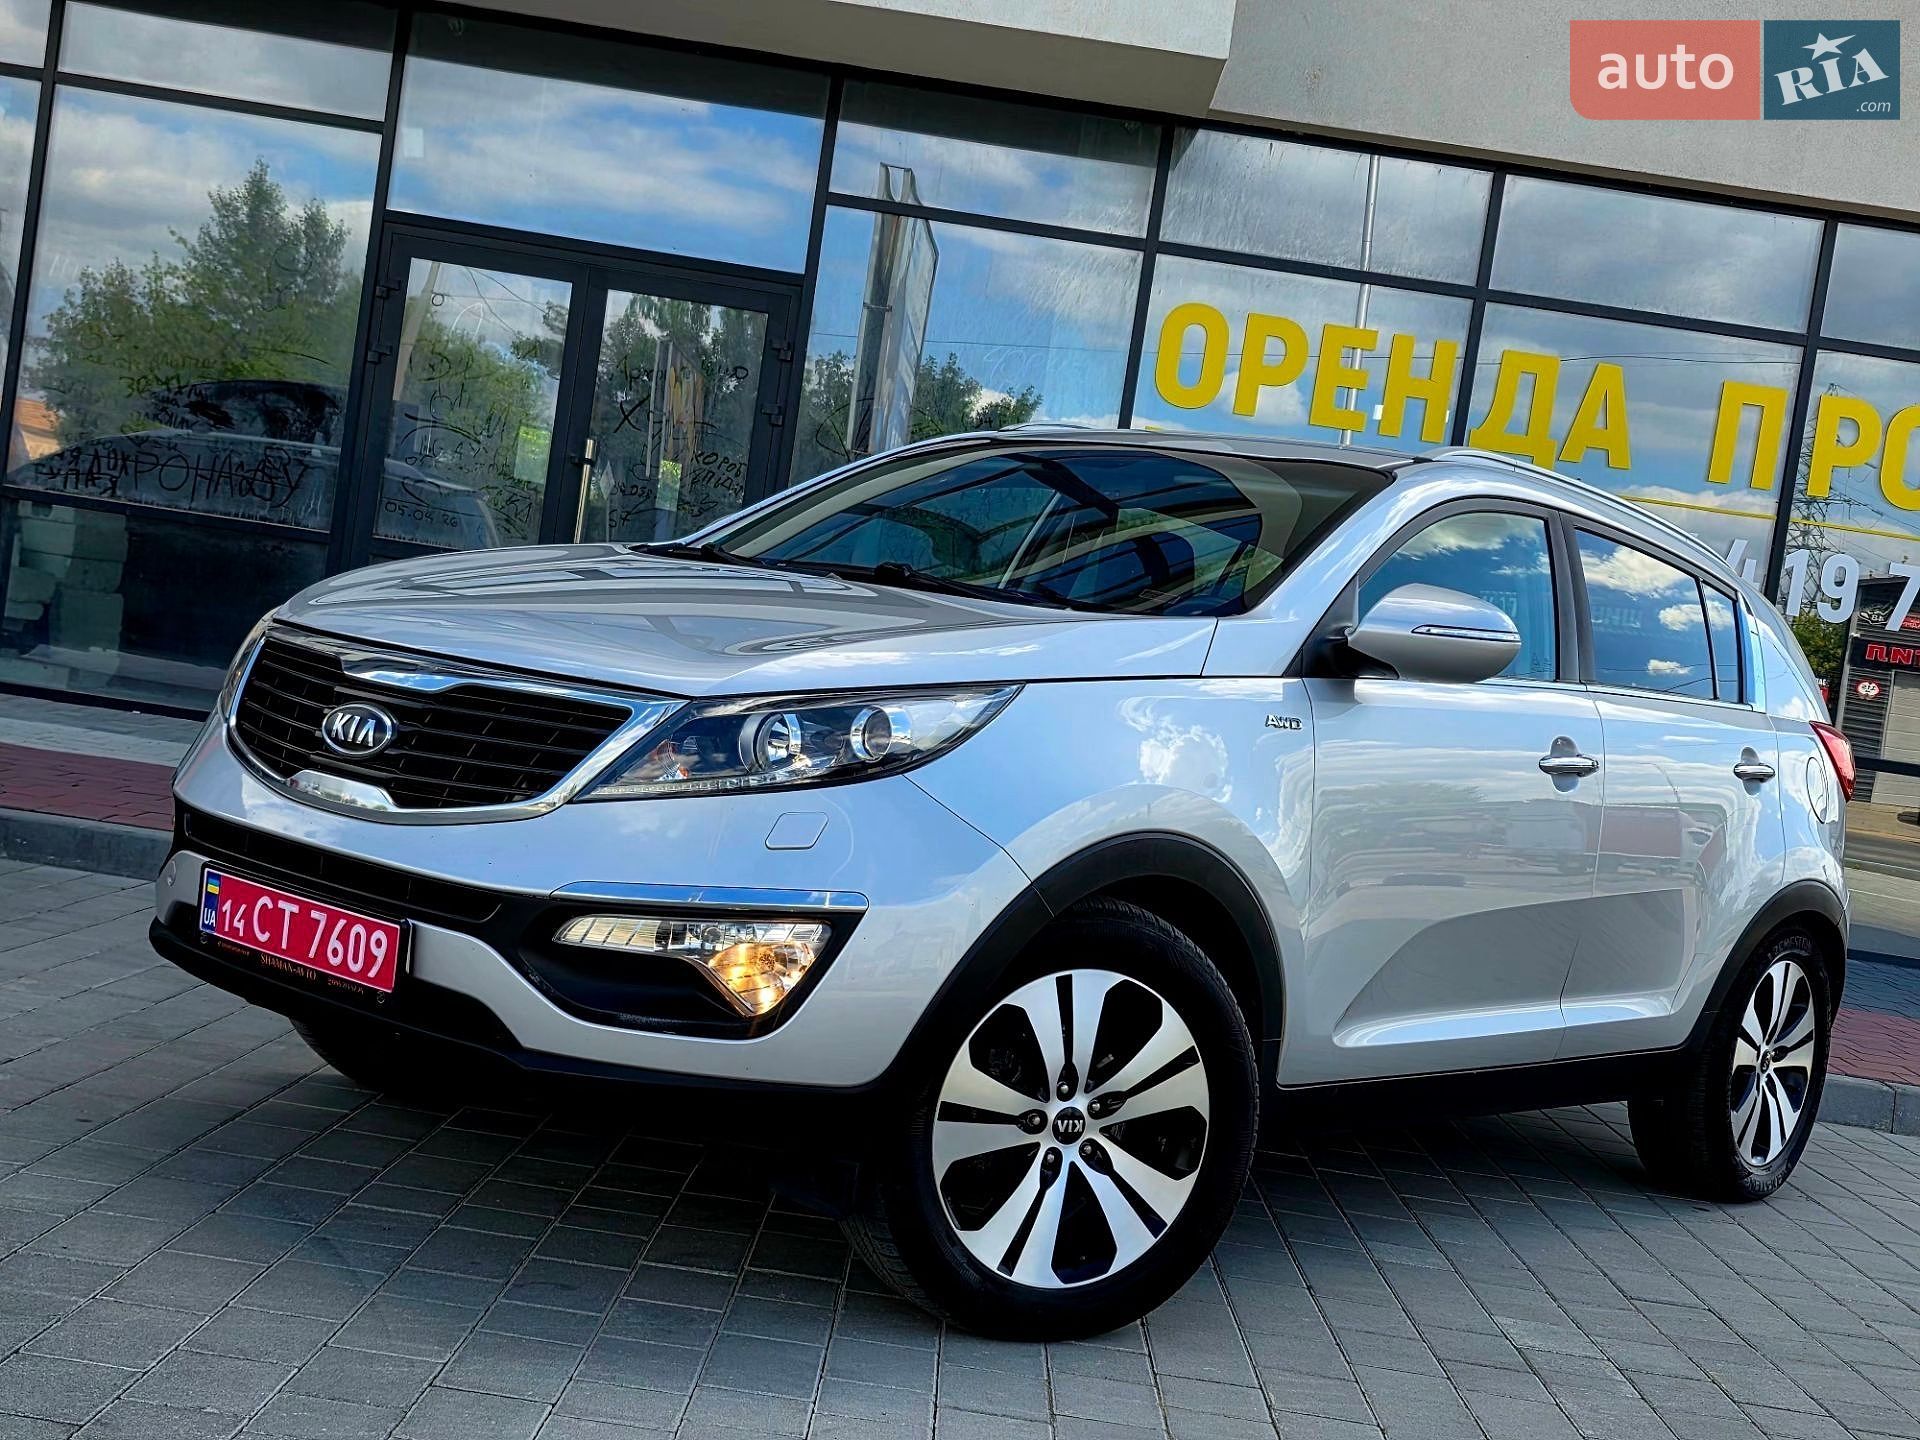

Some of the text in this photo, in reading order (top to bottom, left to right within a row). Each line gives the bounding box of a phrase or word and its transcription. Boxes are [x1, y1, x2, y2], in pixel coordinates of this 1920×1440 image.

[1155, 303, 1631, 470] ОРЕНДА
[331, 712, 376, 747] KIA
[1265, 714, 1303, 730] AWD
[203, 907, 216, 928] UA
[308, 909, 388, 978] 7609
